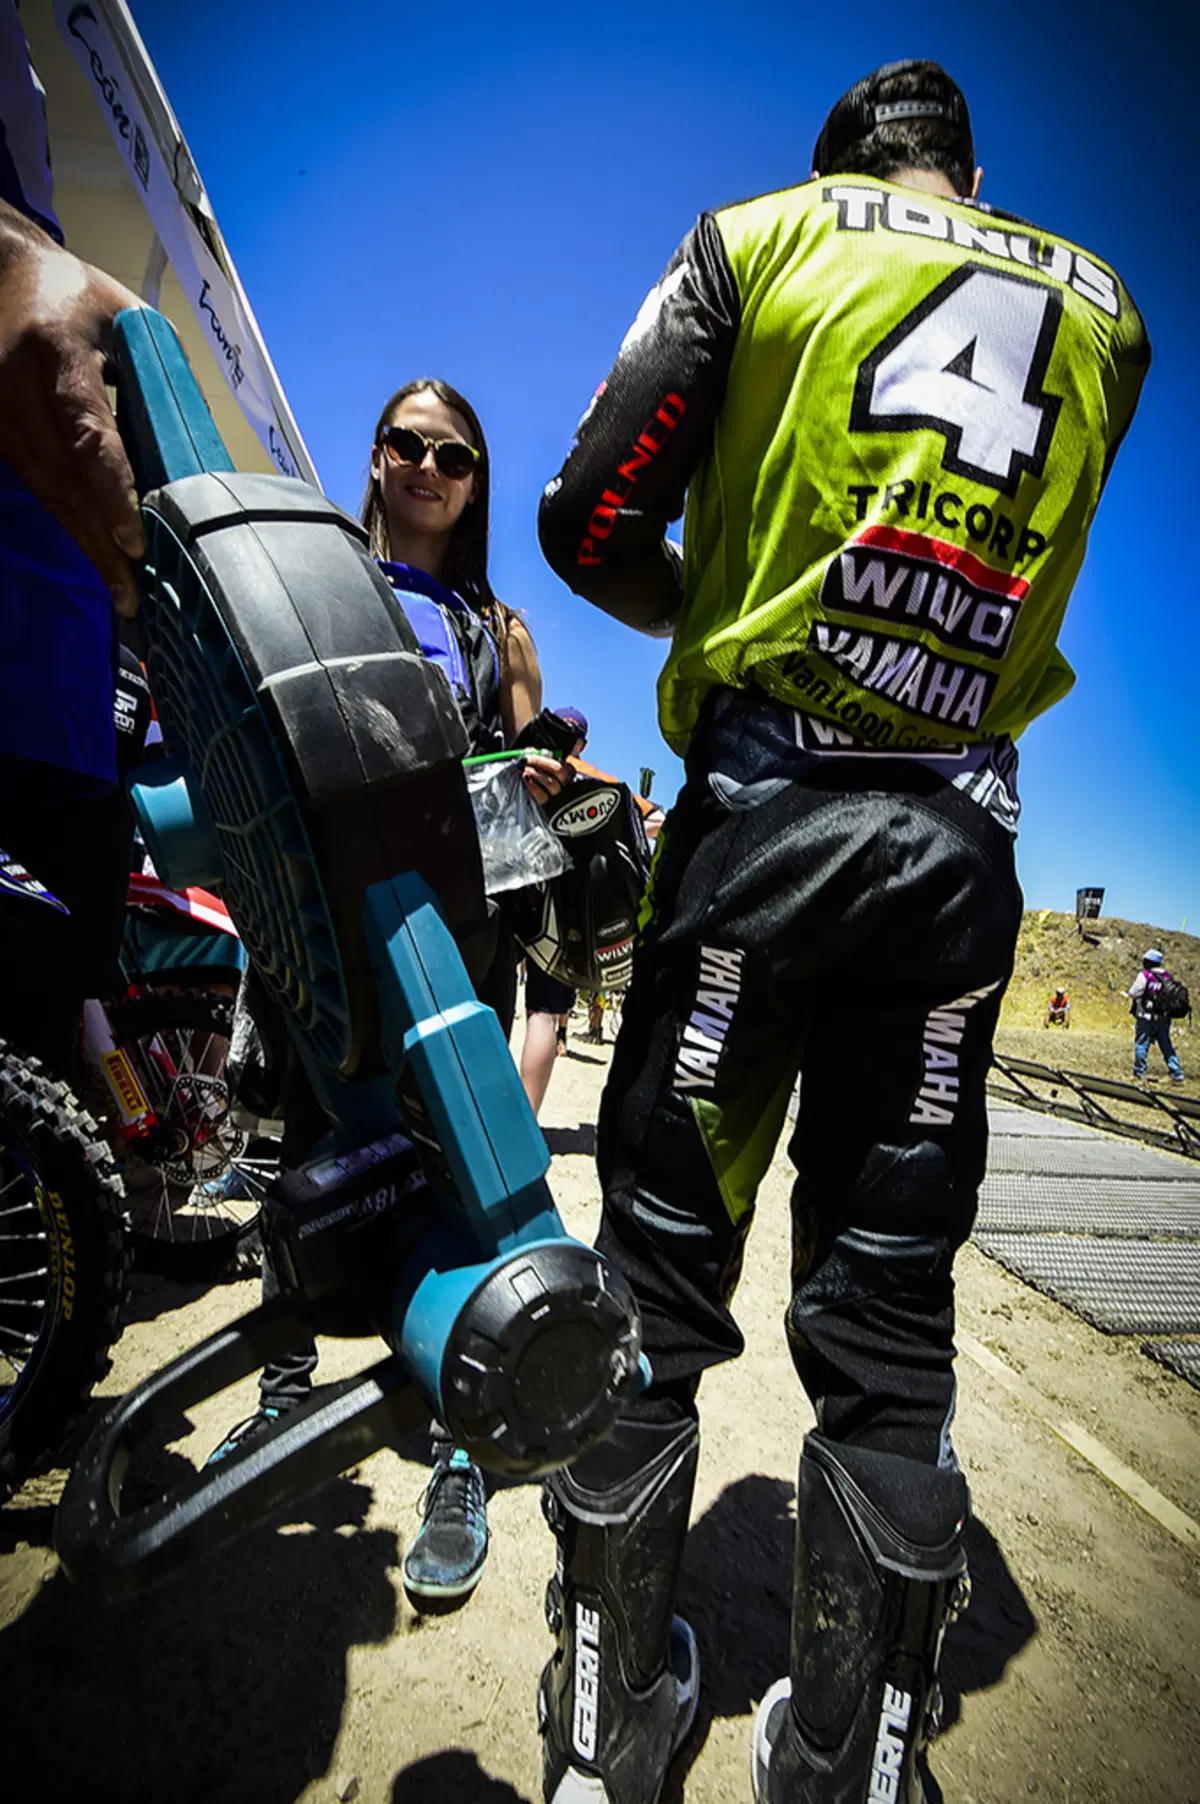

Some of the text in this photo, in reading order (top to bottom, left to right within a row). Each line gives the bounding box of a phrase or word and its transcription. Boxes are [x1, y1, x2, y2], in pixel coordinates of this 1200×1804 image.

[824, 185, 1120, 319] TONUS
[855, 264, 1058, 490] 4
[847, 479, 1046, 563] TRICORP
[840, 552, 1014, 648] WILVO
[816, 625, 988, 729] YAMAHA
[673, 945, 742, 1088] YAMAHA
[106, 1054, 143, 1111] PIRELLI
[48, 1191, 76, 1321] DUNLOP
